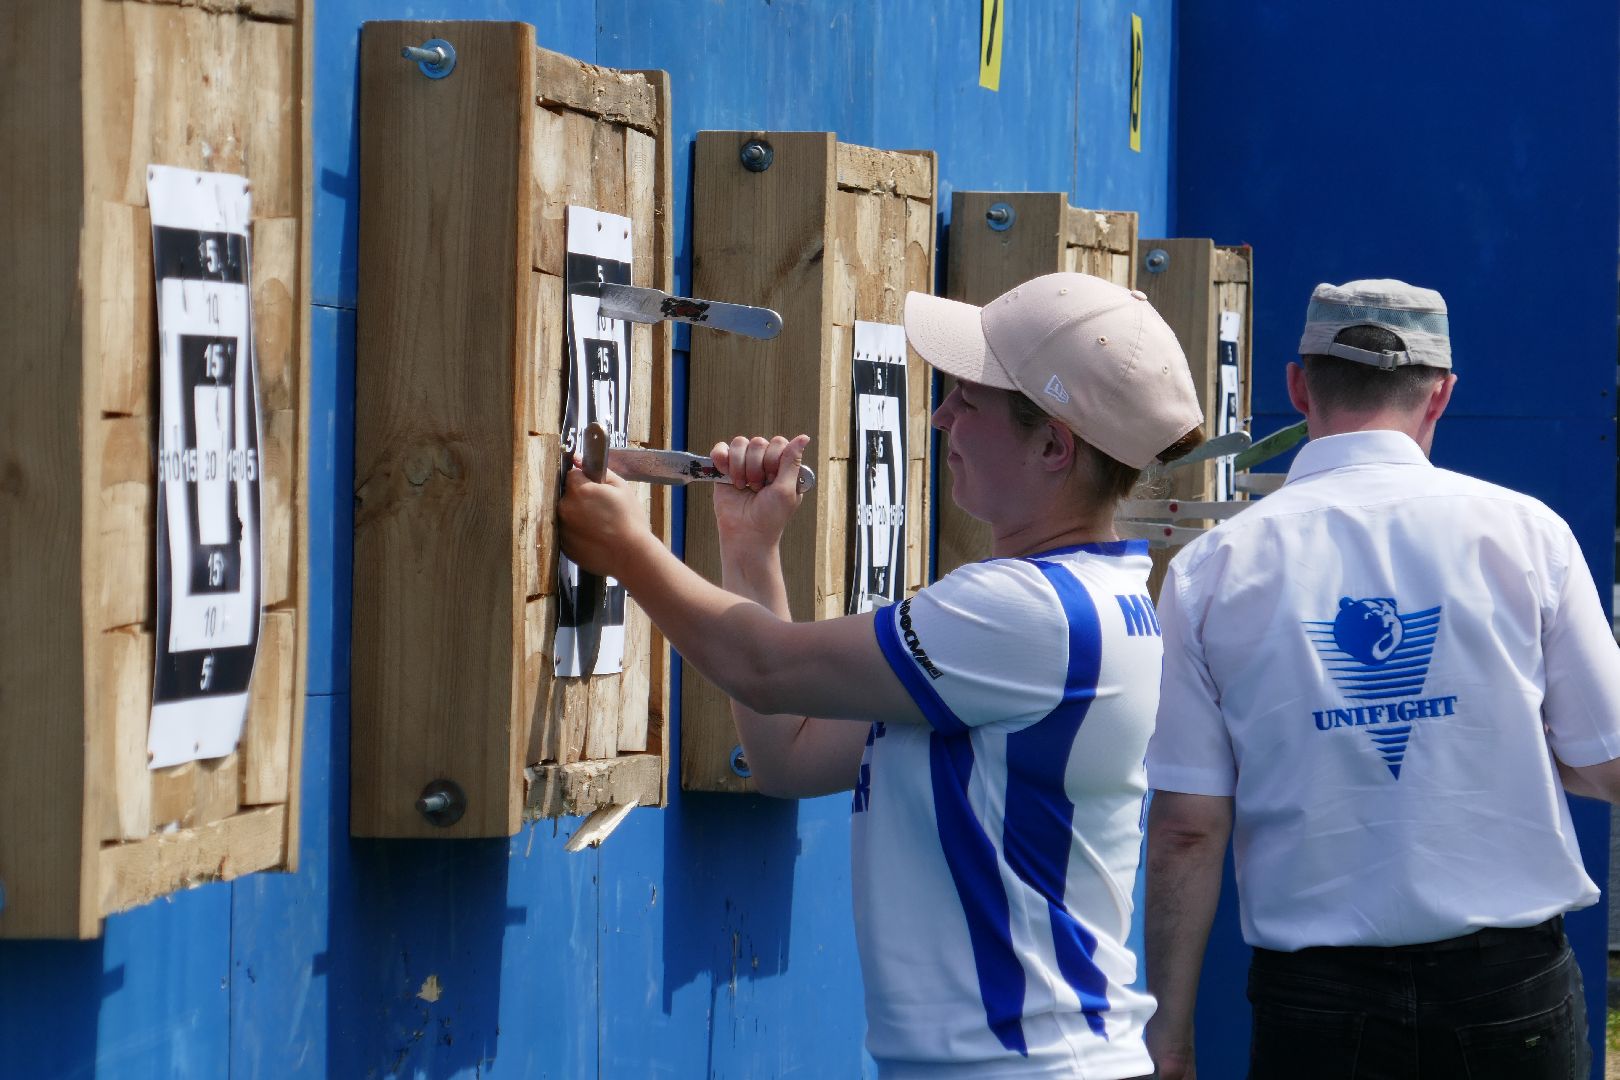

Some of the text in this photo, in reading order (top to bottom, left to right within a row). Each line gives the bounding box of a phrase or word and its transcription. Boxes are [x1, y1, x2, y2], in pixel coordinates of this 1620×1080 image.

[206, 239, 221, 273] 5
[597, 265, 604, 286] 5
[206, 293, 219, 324] 10
[204, 344, 225, 378] 15
[597, 347, 609, 373] 15
[877, 368, 883, 390] 5
[565, 428, 576, 452] 5
[165, 450, 180, 480] 10
[182, 449, 198, 482] 15
[204, 450, 217, 480] 20
[246, 449, 257, 482] 5
[208, 553, 222, 587] 15
[204, 606, 217, 637] 10
[200, 657, 213, 691] 5
[1312, 695, 1458, 731] UNIFIGHT
